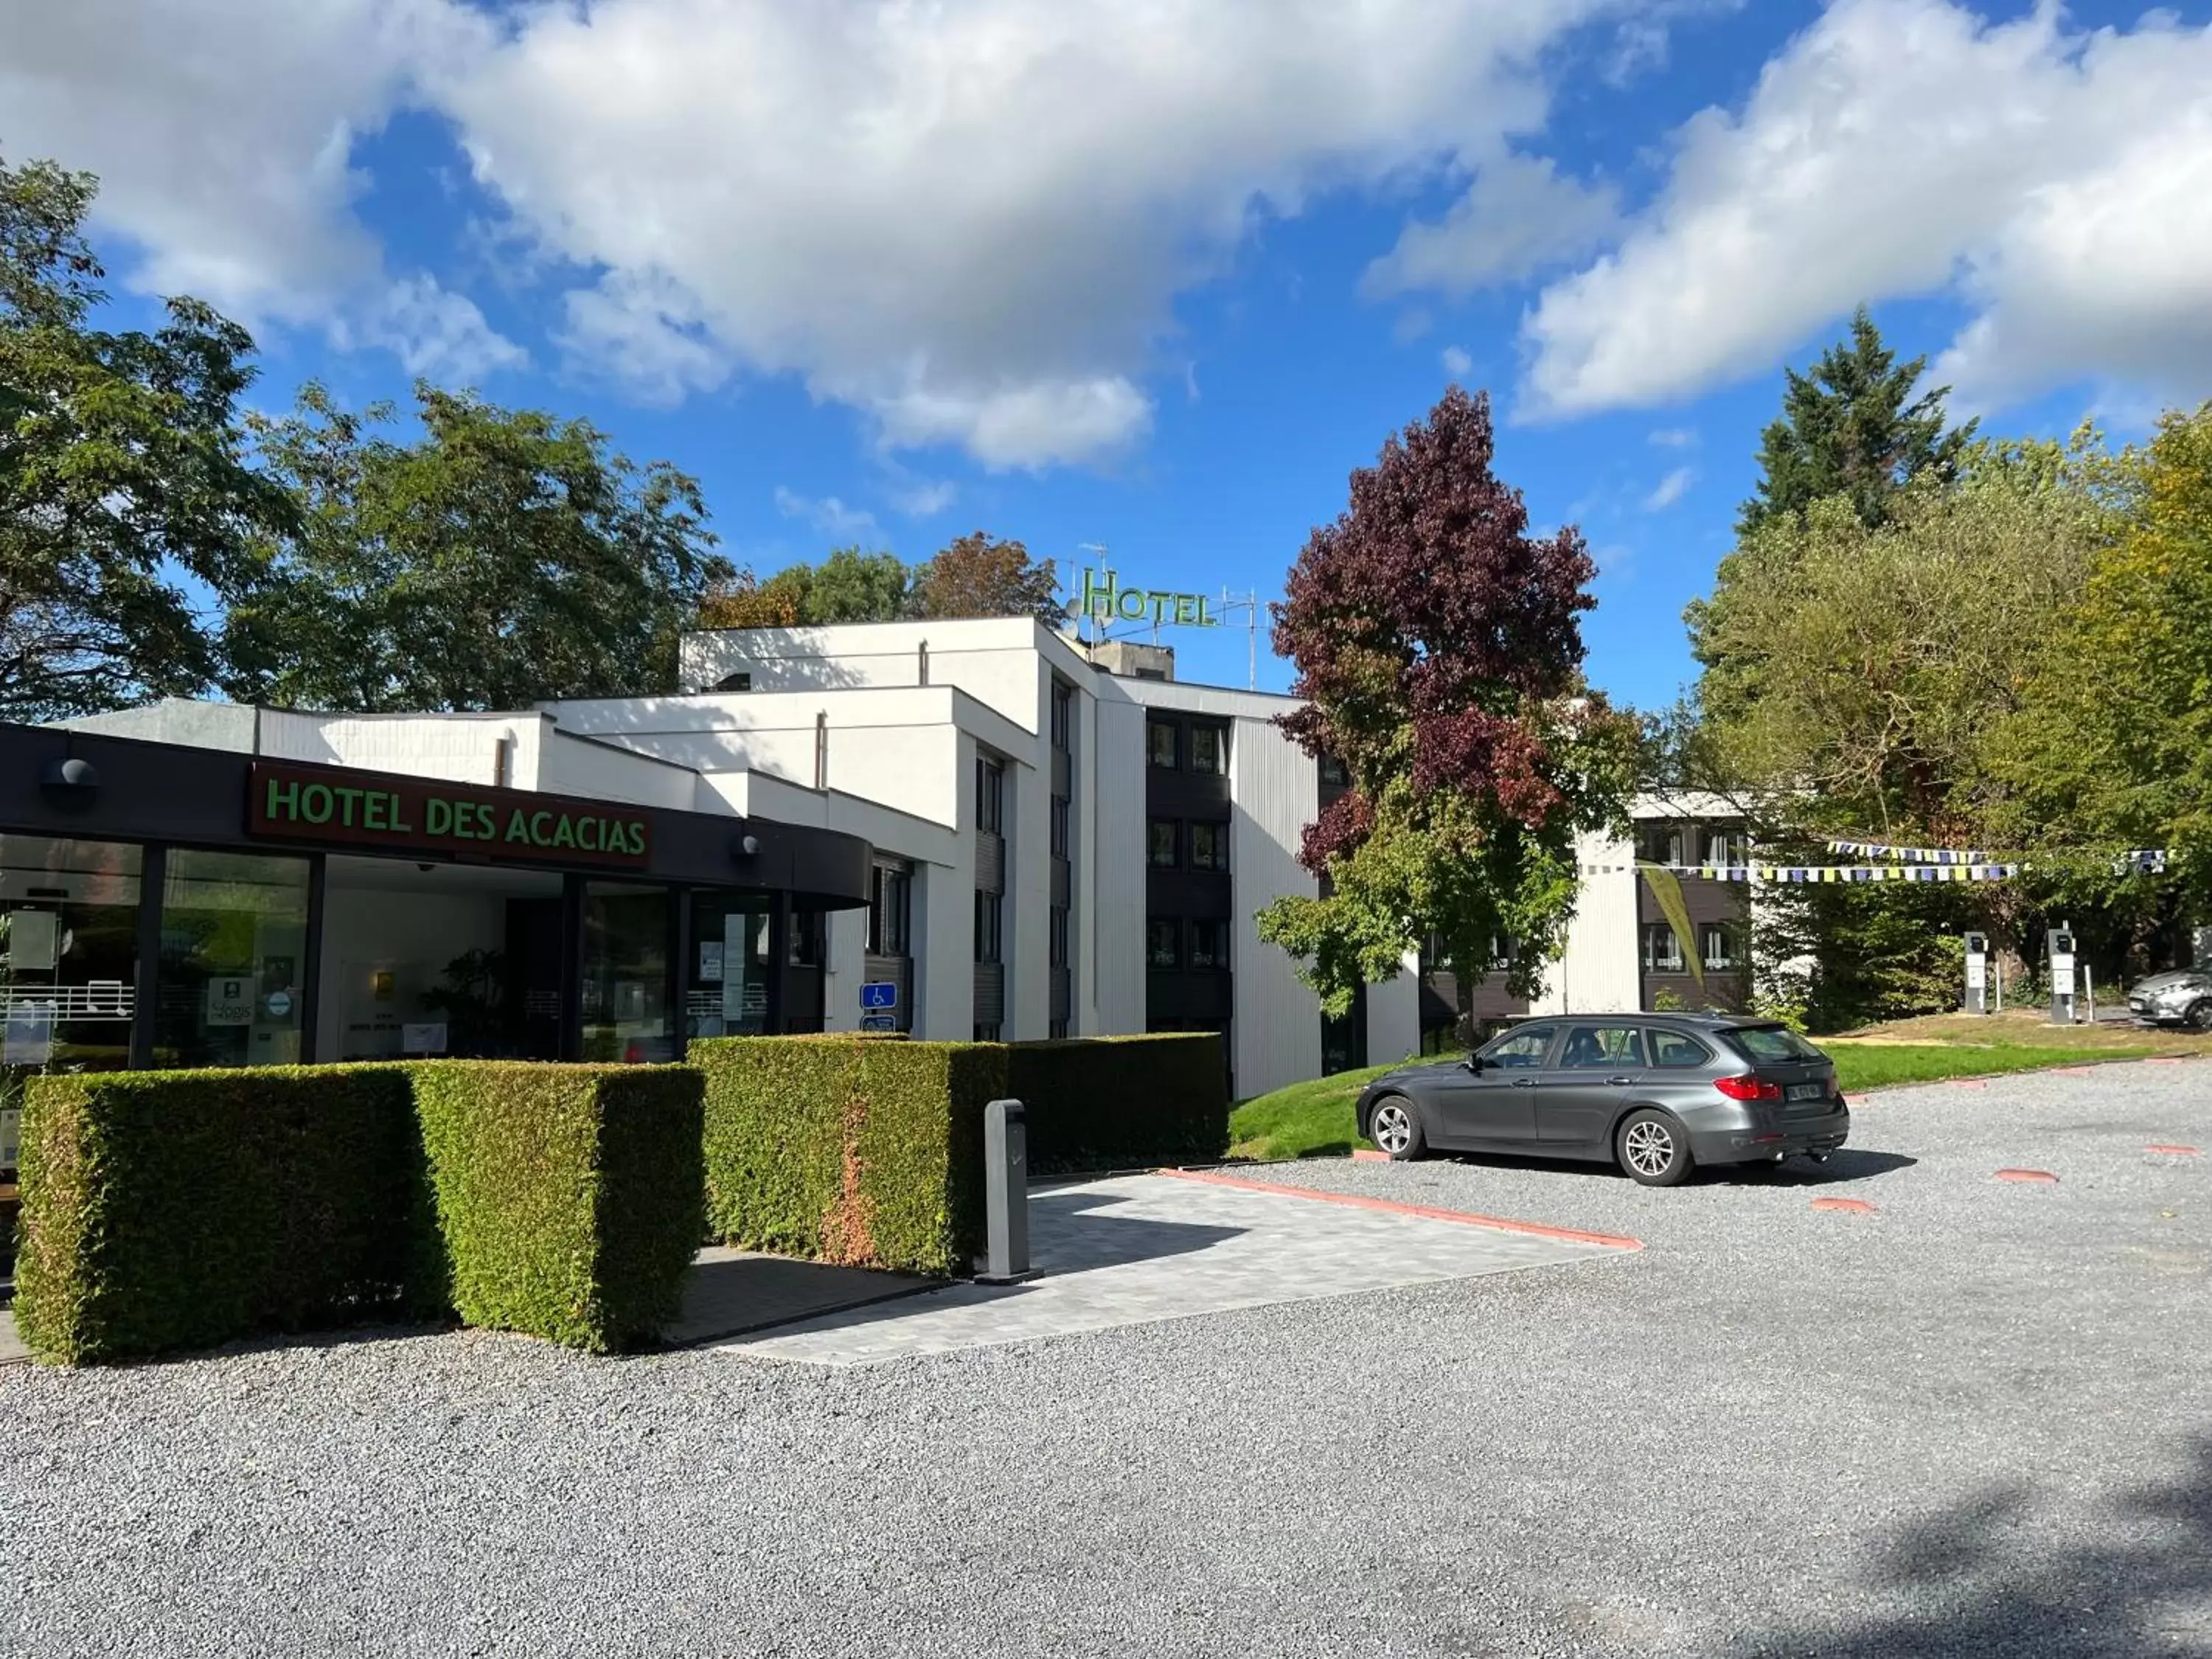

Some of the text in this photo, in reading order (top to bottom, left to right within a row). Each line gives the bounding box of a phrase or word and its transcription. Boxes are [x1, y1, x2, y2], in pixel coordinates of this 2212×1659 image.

[1082, 567, 1217, 626] HOTEL
[266, 779, 646, 855] HOTEL DES ACACIAS
